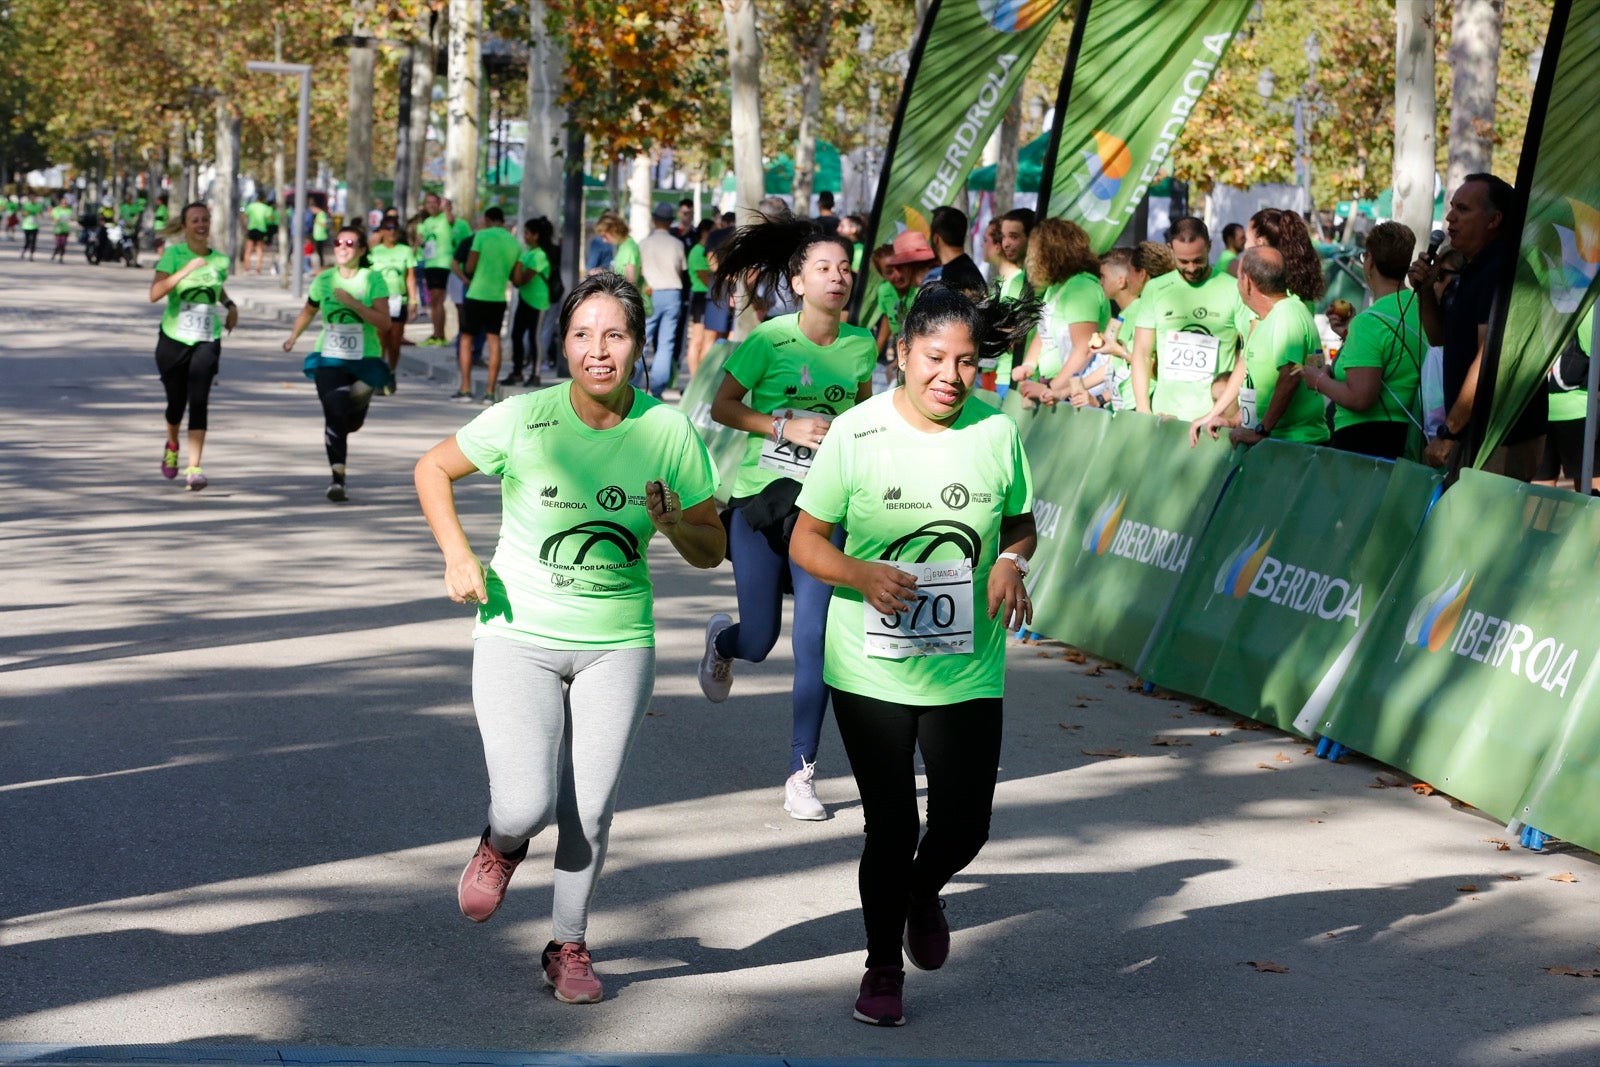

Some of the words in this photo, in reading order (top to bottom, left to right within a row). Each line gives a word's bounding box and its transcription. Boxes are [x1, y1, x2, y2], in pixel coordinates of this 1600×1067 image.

[920, 54, 1018, 210] IBERDROLA
[329, 334, 358, 350] 320
[1170, 347, 1207, 369] 293
[541, 499, 588, 510] IBERDROLA
[886, 501, 933, 510] IBERDROLA
[1109, 519, 1194, 574] IBERDROLA
[549, 563, 575, 571] FORMA
